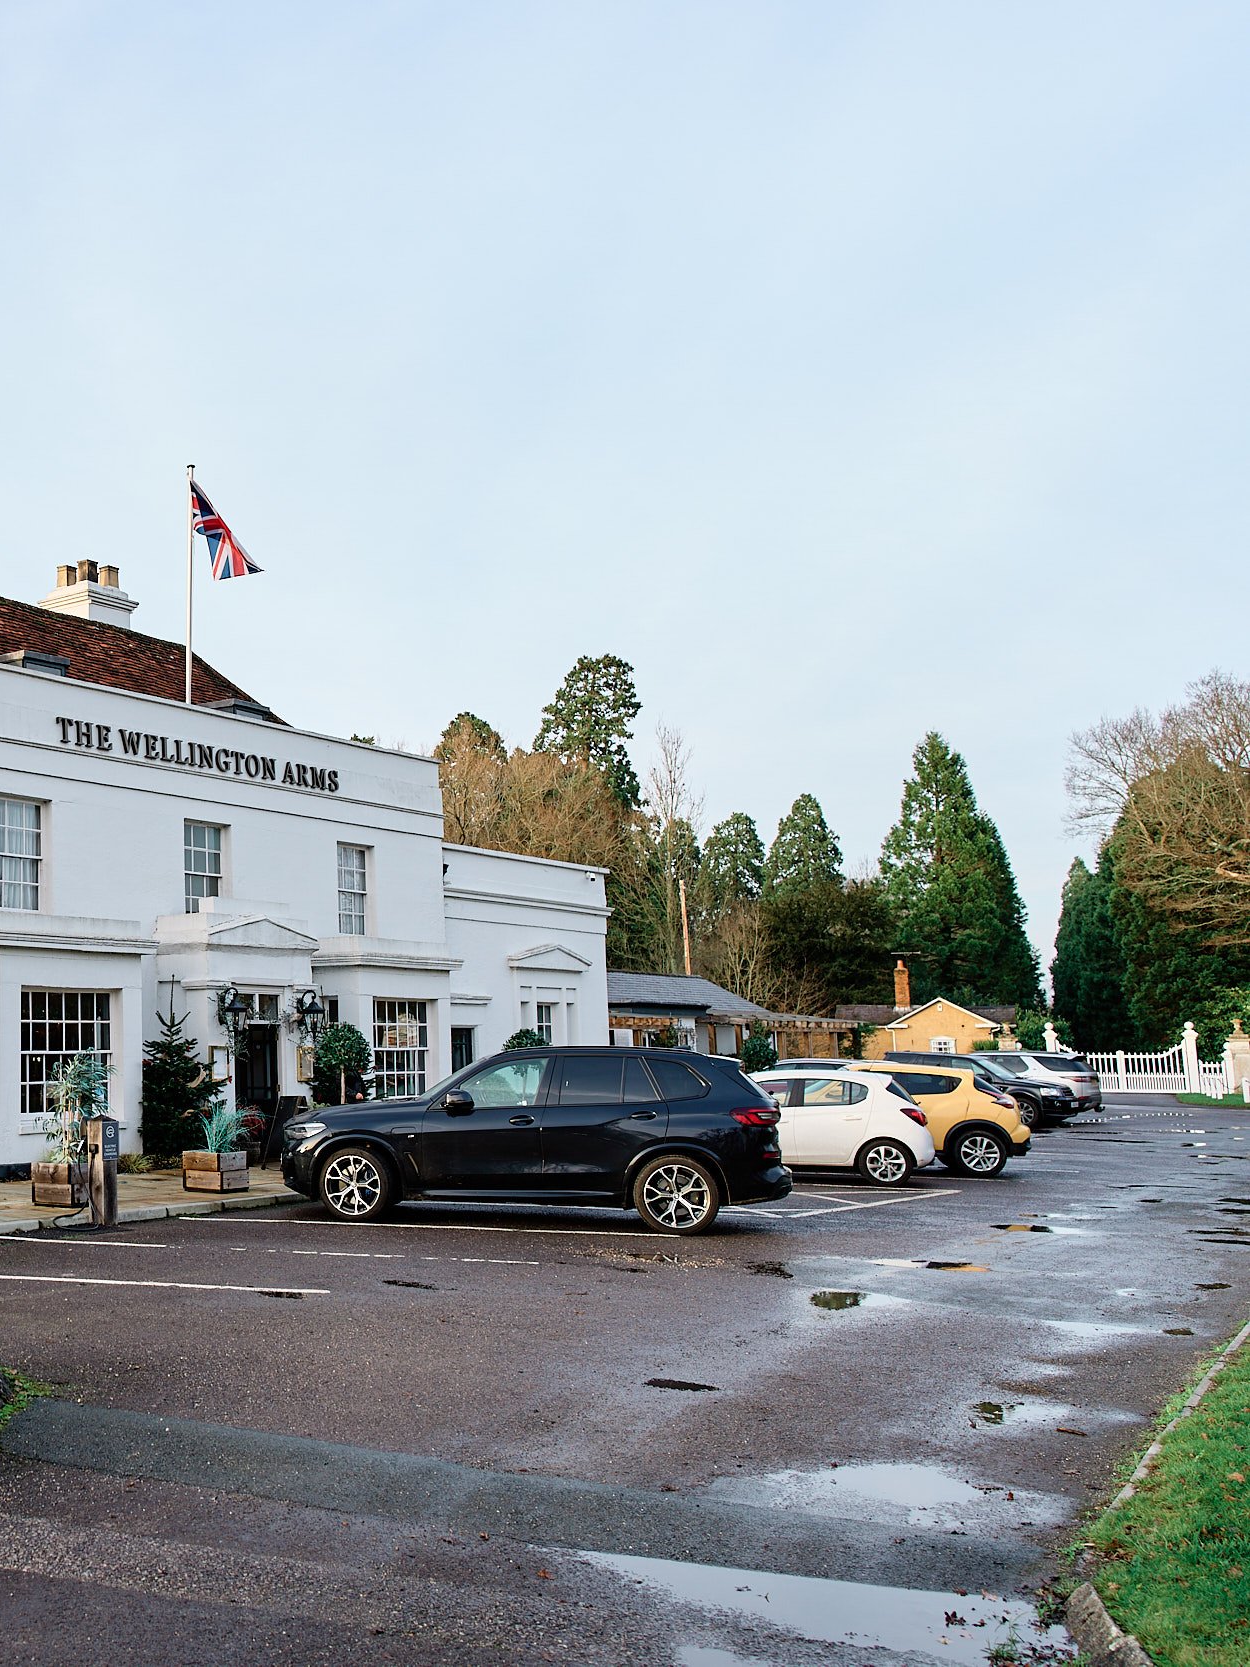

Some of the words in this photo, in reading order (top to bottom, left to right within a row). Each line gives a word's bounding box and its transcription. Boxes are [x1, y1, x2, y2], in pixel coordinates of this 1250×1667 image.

[55, 716, 113, 751] THE
[117, 728, 277, 781] WELLINGTON
[281, 761, 340, 792] ARMS
